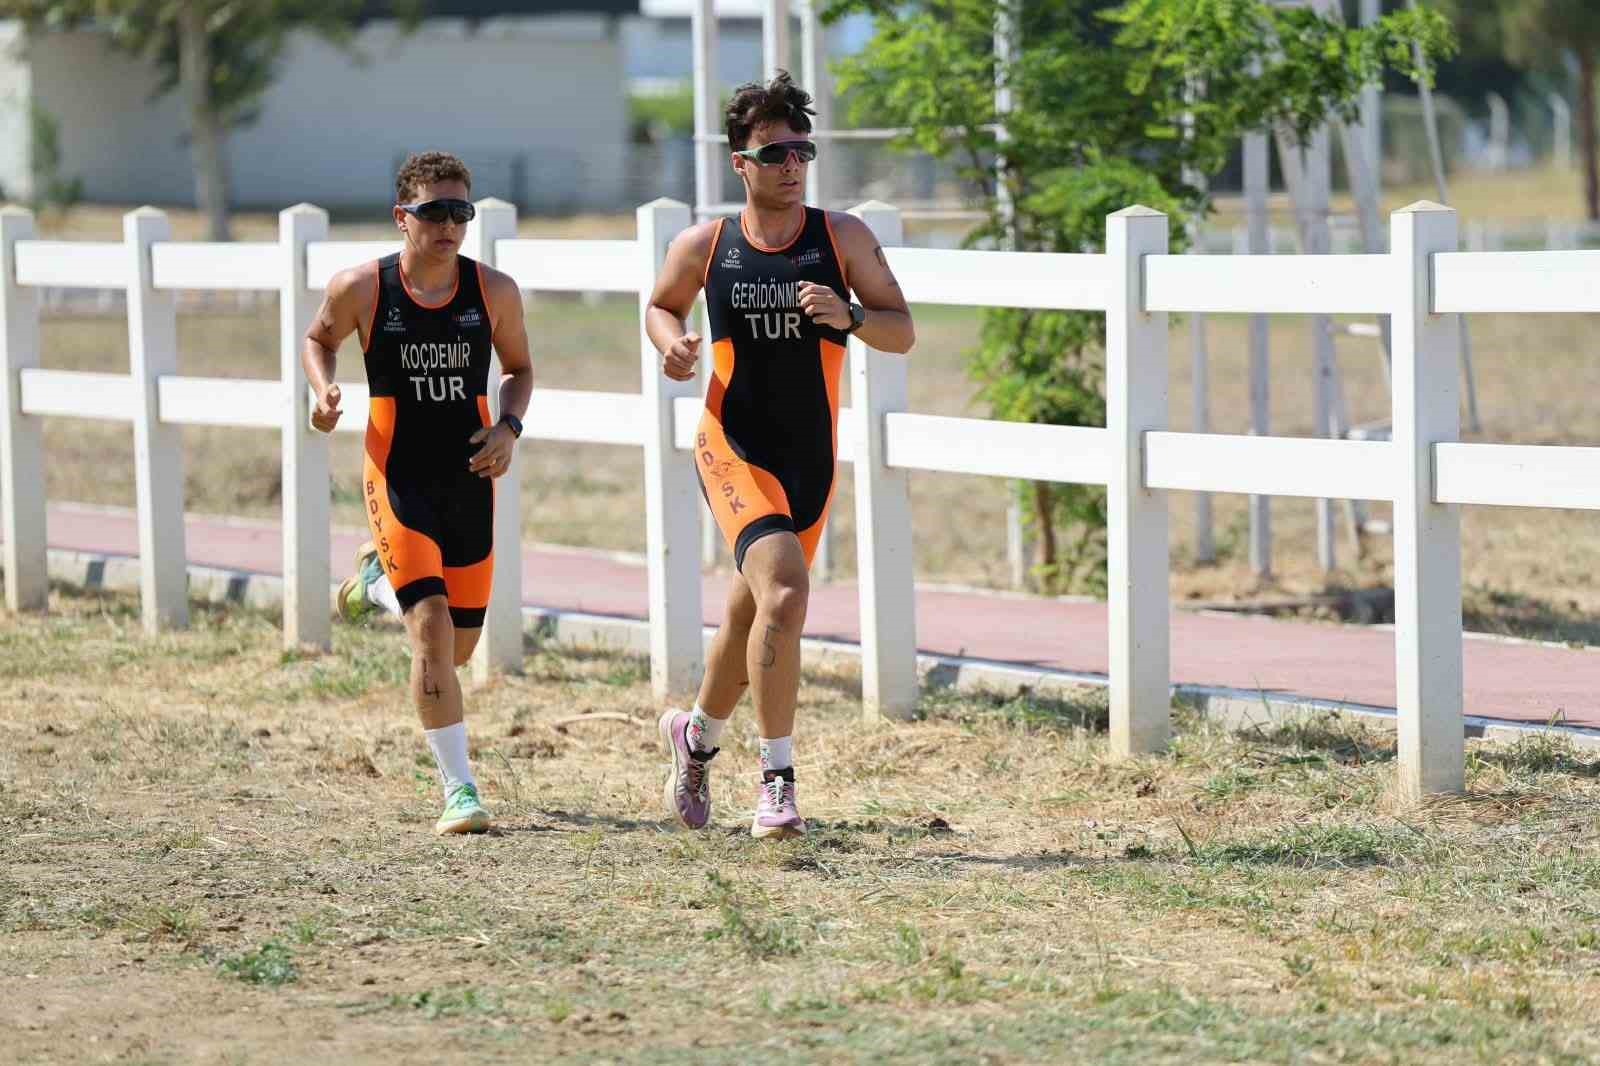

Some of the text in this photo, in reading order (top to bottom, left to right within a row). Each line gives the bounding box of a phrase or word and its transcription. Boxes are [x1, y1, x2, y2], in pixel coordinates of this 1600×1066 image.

[731, 276, 801, 309] GERİDÖNME
[744, 312, 801, 339] TUR
[400, 335, 471, 376] KOÇDEMİR
[409, 376, 466, 401] TUR
[366, 480, 399, 574] BOYSK
